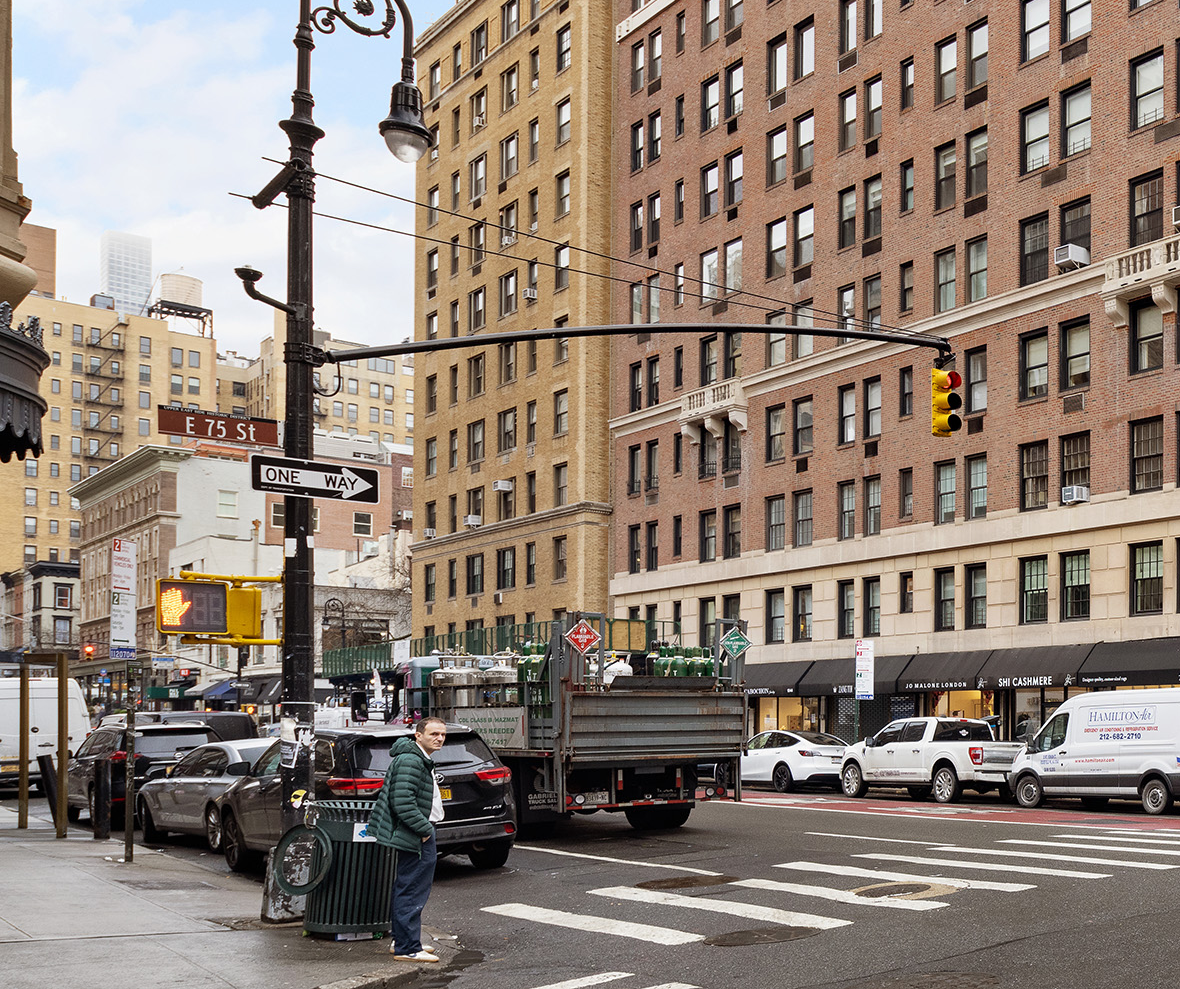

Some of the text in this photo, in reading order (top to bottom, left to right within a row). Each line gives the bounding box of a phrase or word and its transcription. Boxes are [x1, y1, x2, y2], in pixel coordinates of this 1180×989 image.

[185, 416, 256, 442] E 75 St
[265, 467, 358, 491] ONE WAY
[115, 540, 120, 551] 2
[998, 675, 1053, 687] SHI CASHMERE
[1099, 732, 1142, 740] 212-682-2710
